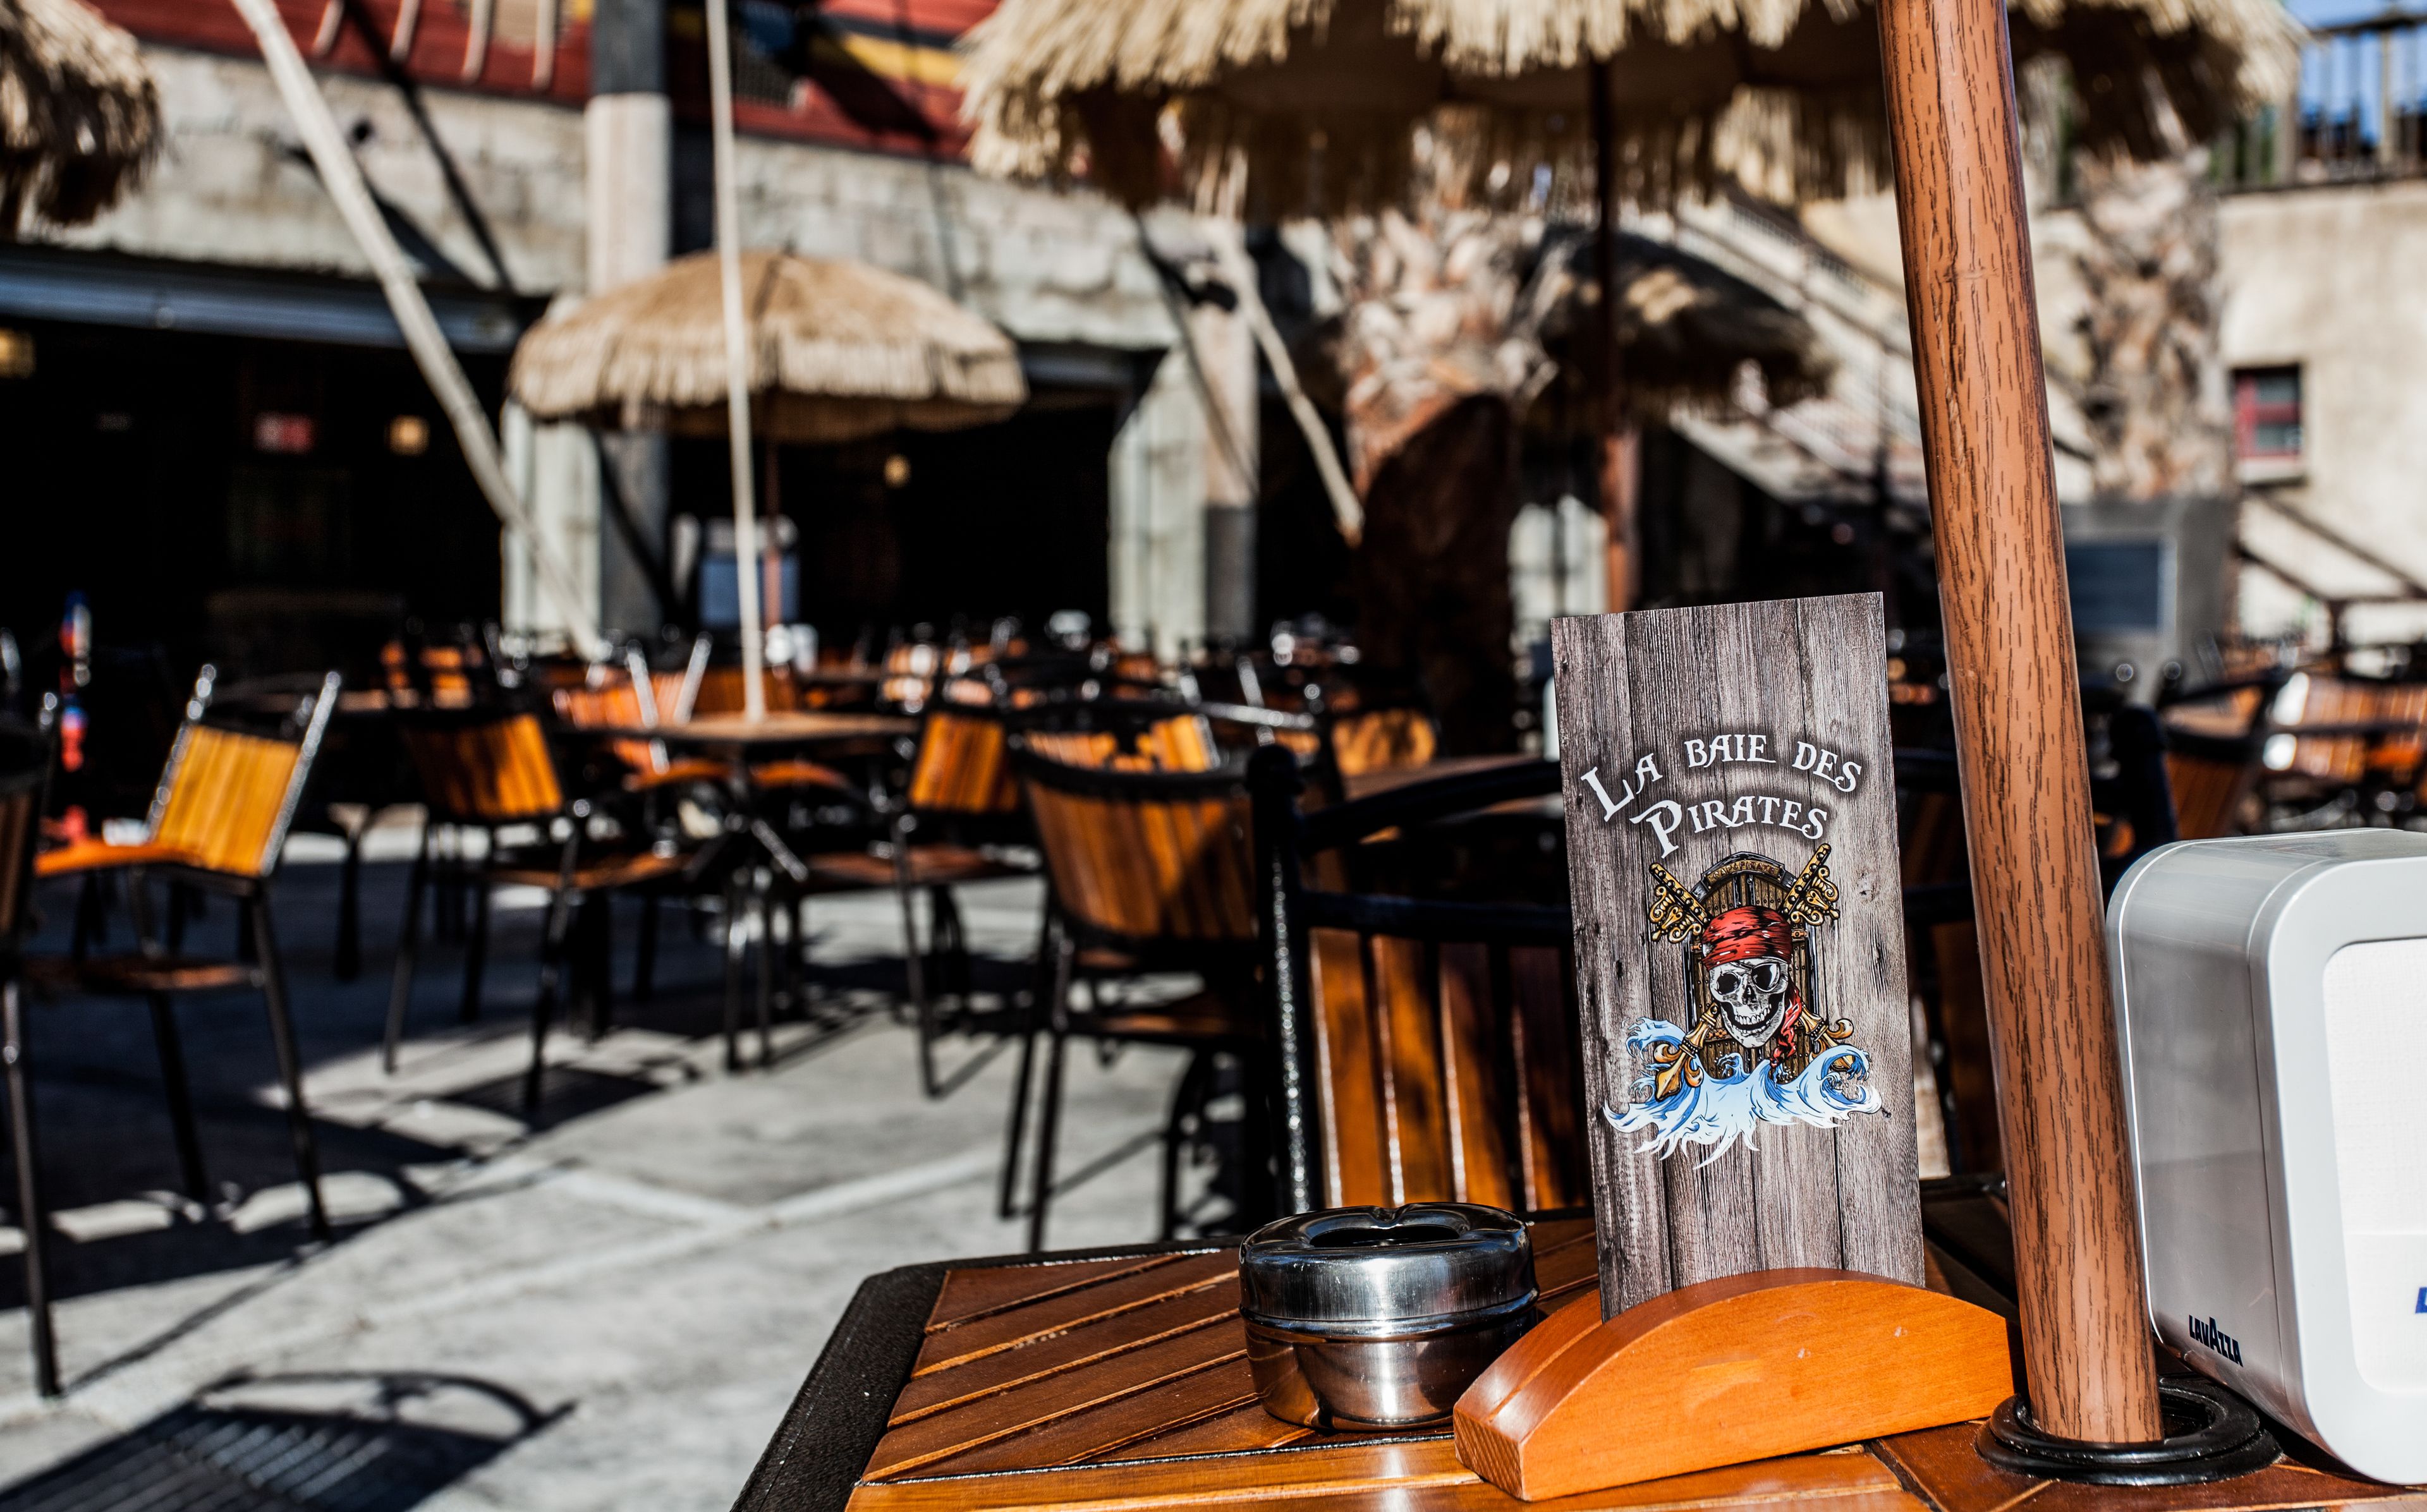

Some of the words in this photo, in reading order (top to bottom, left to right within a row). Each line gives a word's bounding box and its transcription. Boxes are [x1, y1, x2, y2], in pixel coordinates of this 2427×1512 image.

[1684, 734, 1776, 768] BAIE
[1792, 741, 1862, 792] DES
[1629, 795, 1828, 859] PIRATES
[2189, 1314, 2244, 1368] LAVAZZA
